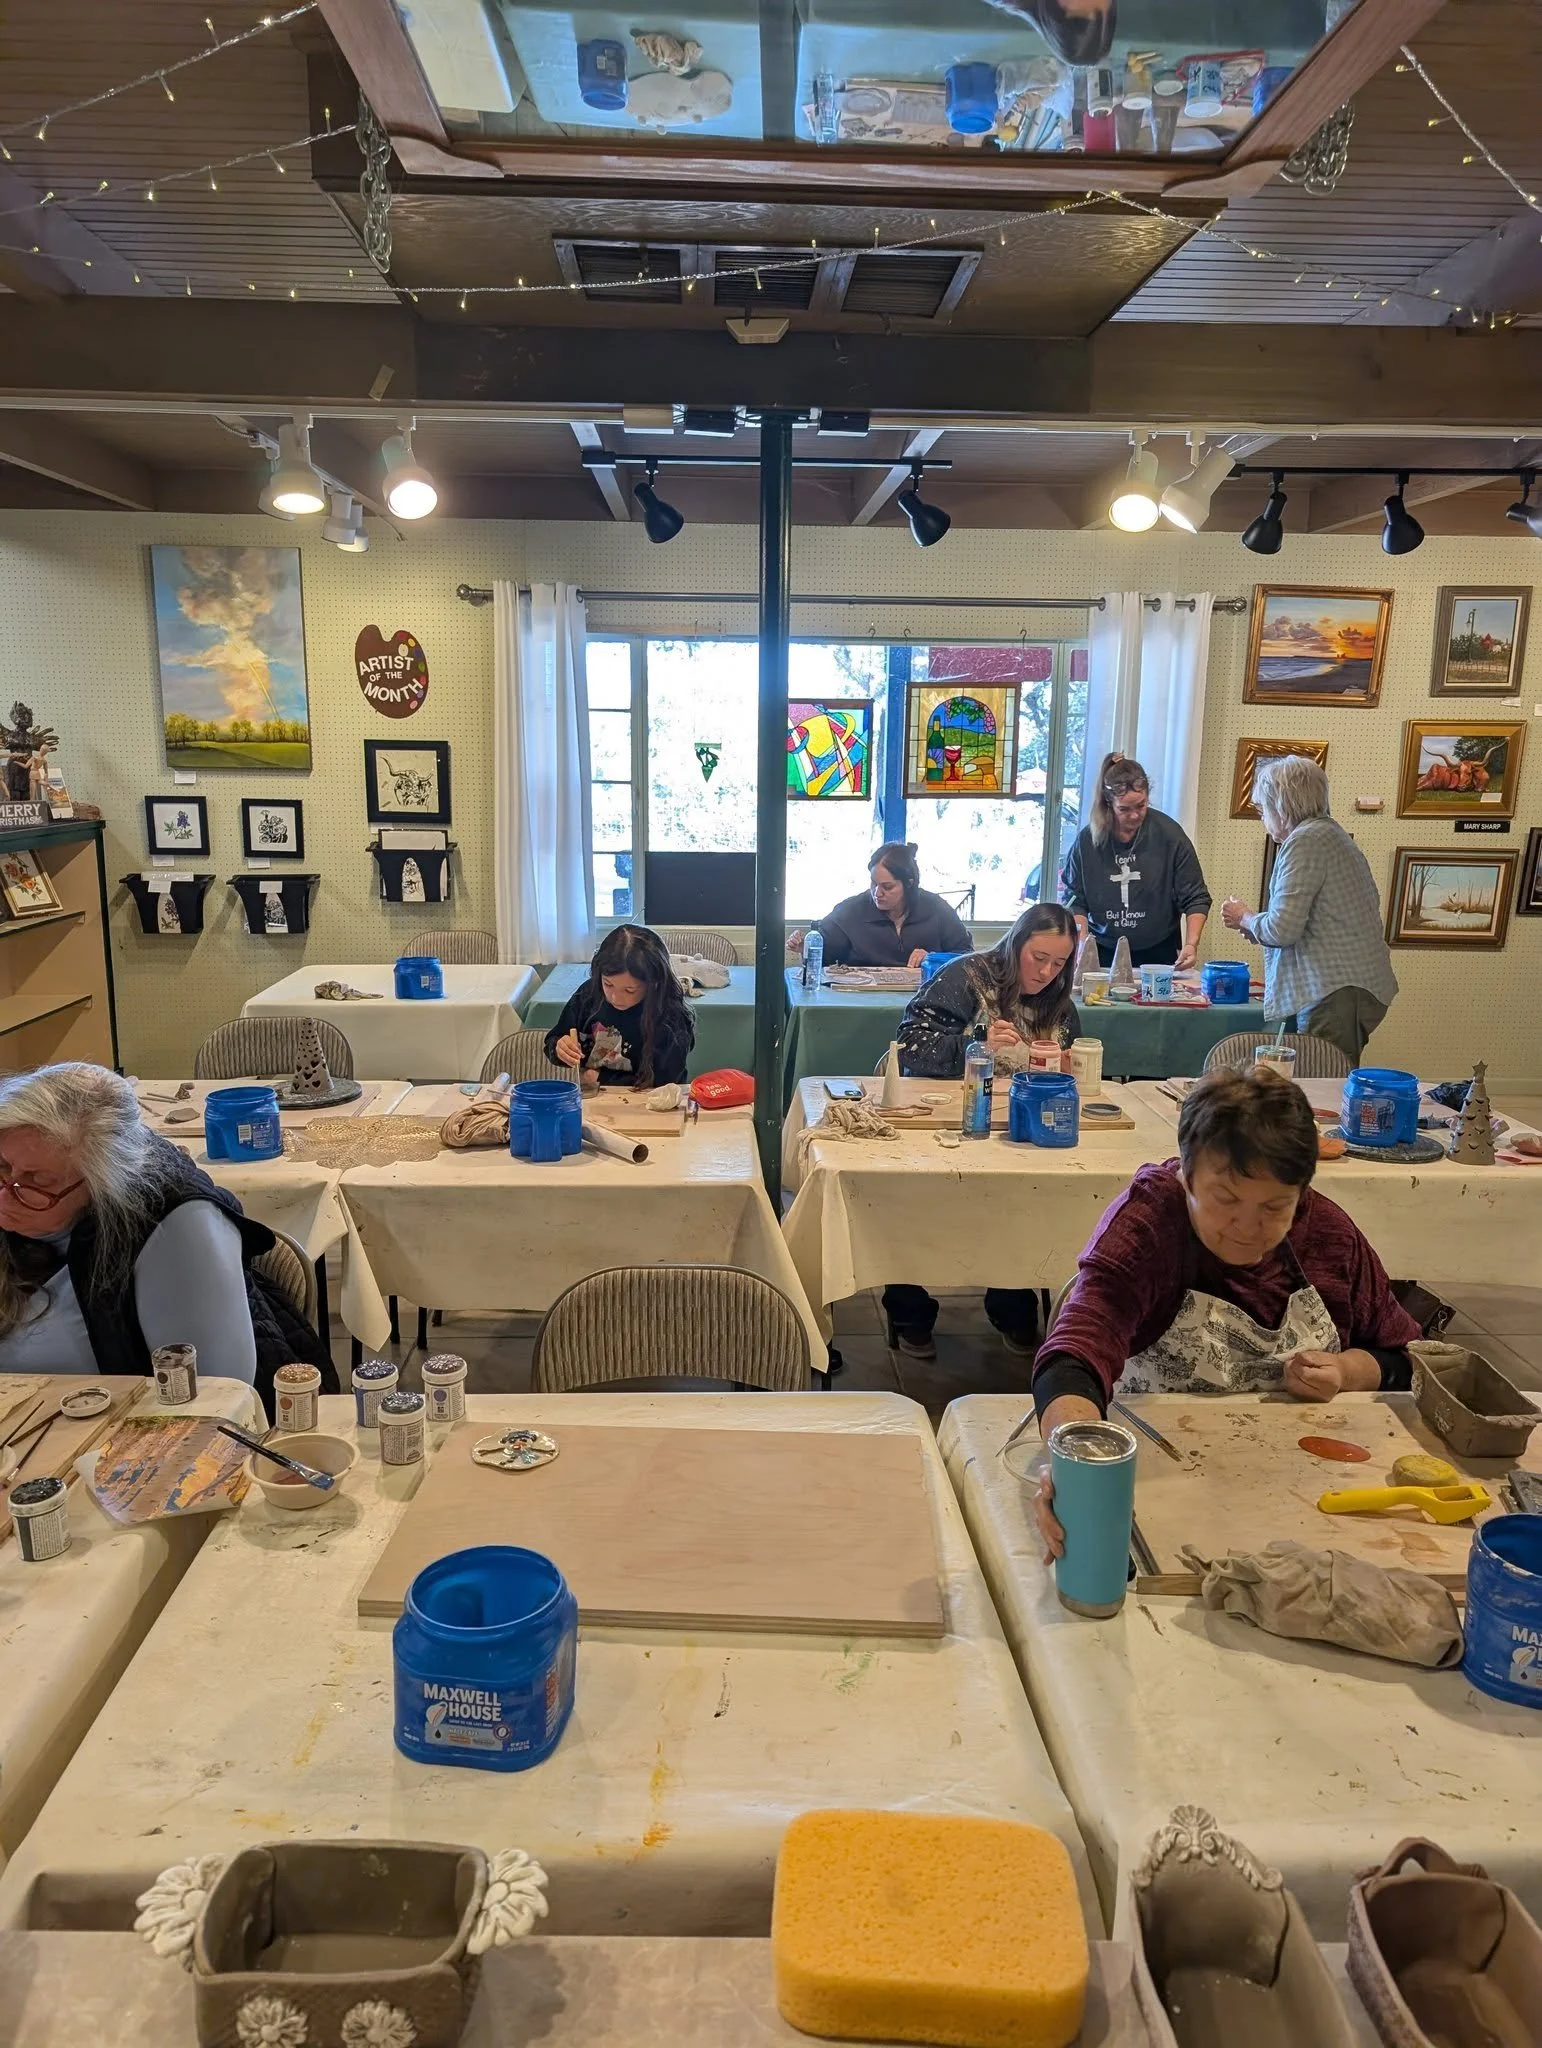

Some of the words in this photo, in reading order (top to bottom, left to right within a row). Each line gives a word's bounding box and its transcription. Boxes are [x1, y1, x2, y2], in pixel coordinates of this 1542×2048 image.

[359, 655, 414, 676] ARTIST
[369, 673, 381, 682] OF
[385, 671, 403, 679] THE
[363, 678, 423, 702] MONTH
[1106, 910, 1120, 919] But
[1126, 910, 1146, 919] know
[1512, 1625, 1542, 1647] MA
[424, 1683, 501, 1707] MAXWELL
[448, 1702, 502, 1722] HOUSE
